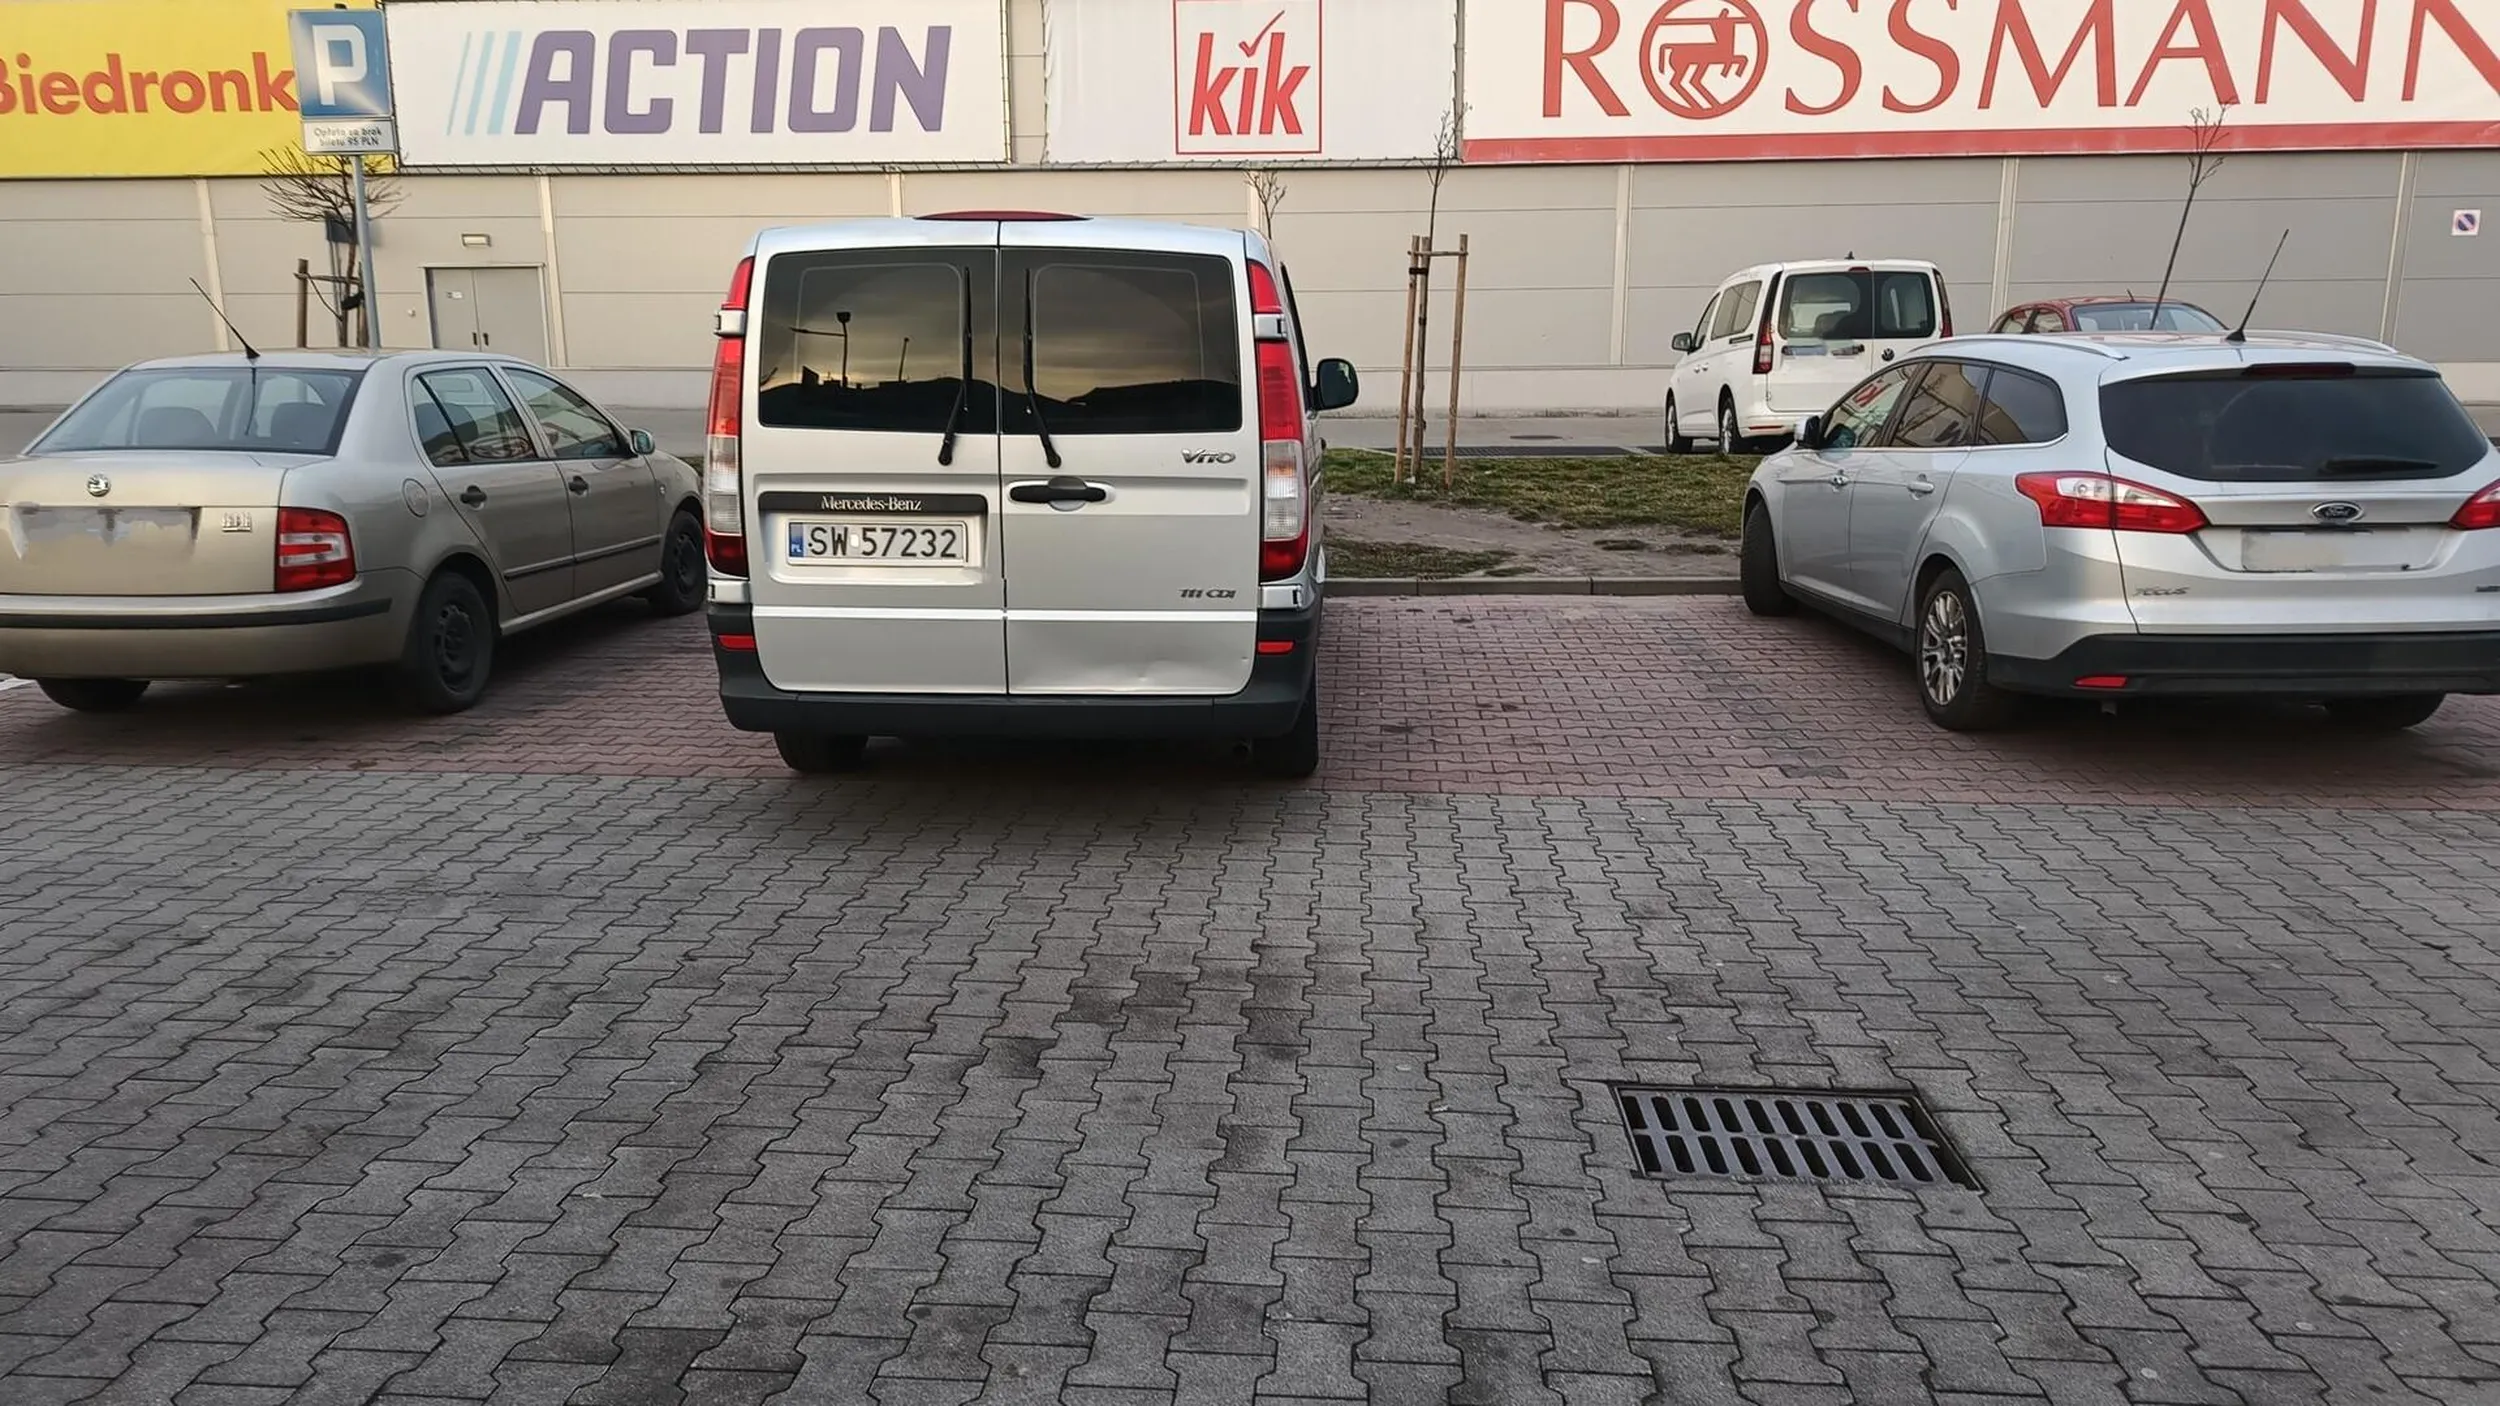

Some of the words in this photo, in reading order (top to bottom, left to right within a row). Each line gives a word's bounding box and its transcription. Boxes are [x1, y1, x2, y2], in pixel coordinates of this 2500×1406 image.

[312, 24, 367, 106] P
[1542, 0, 2500, 119] ROSSMANN
[514, 25, 952, 135] ACTION
[361, 135, 379, 146] PLN
[821, 495, 922, 511] Mercedes-Benz
[809, 526, 848, 556] SW
[861, 527, 957, 558] 57232
[1205, 589, 1237, 598] CDI
